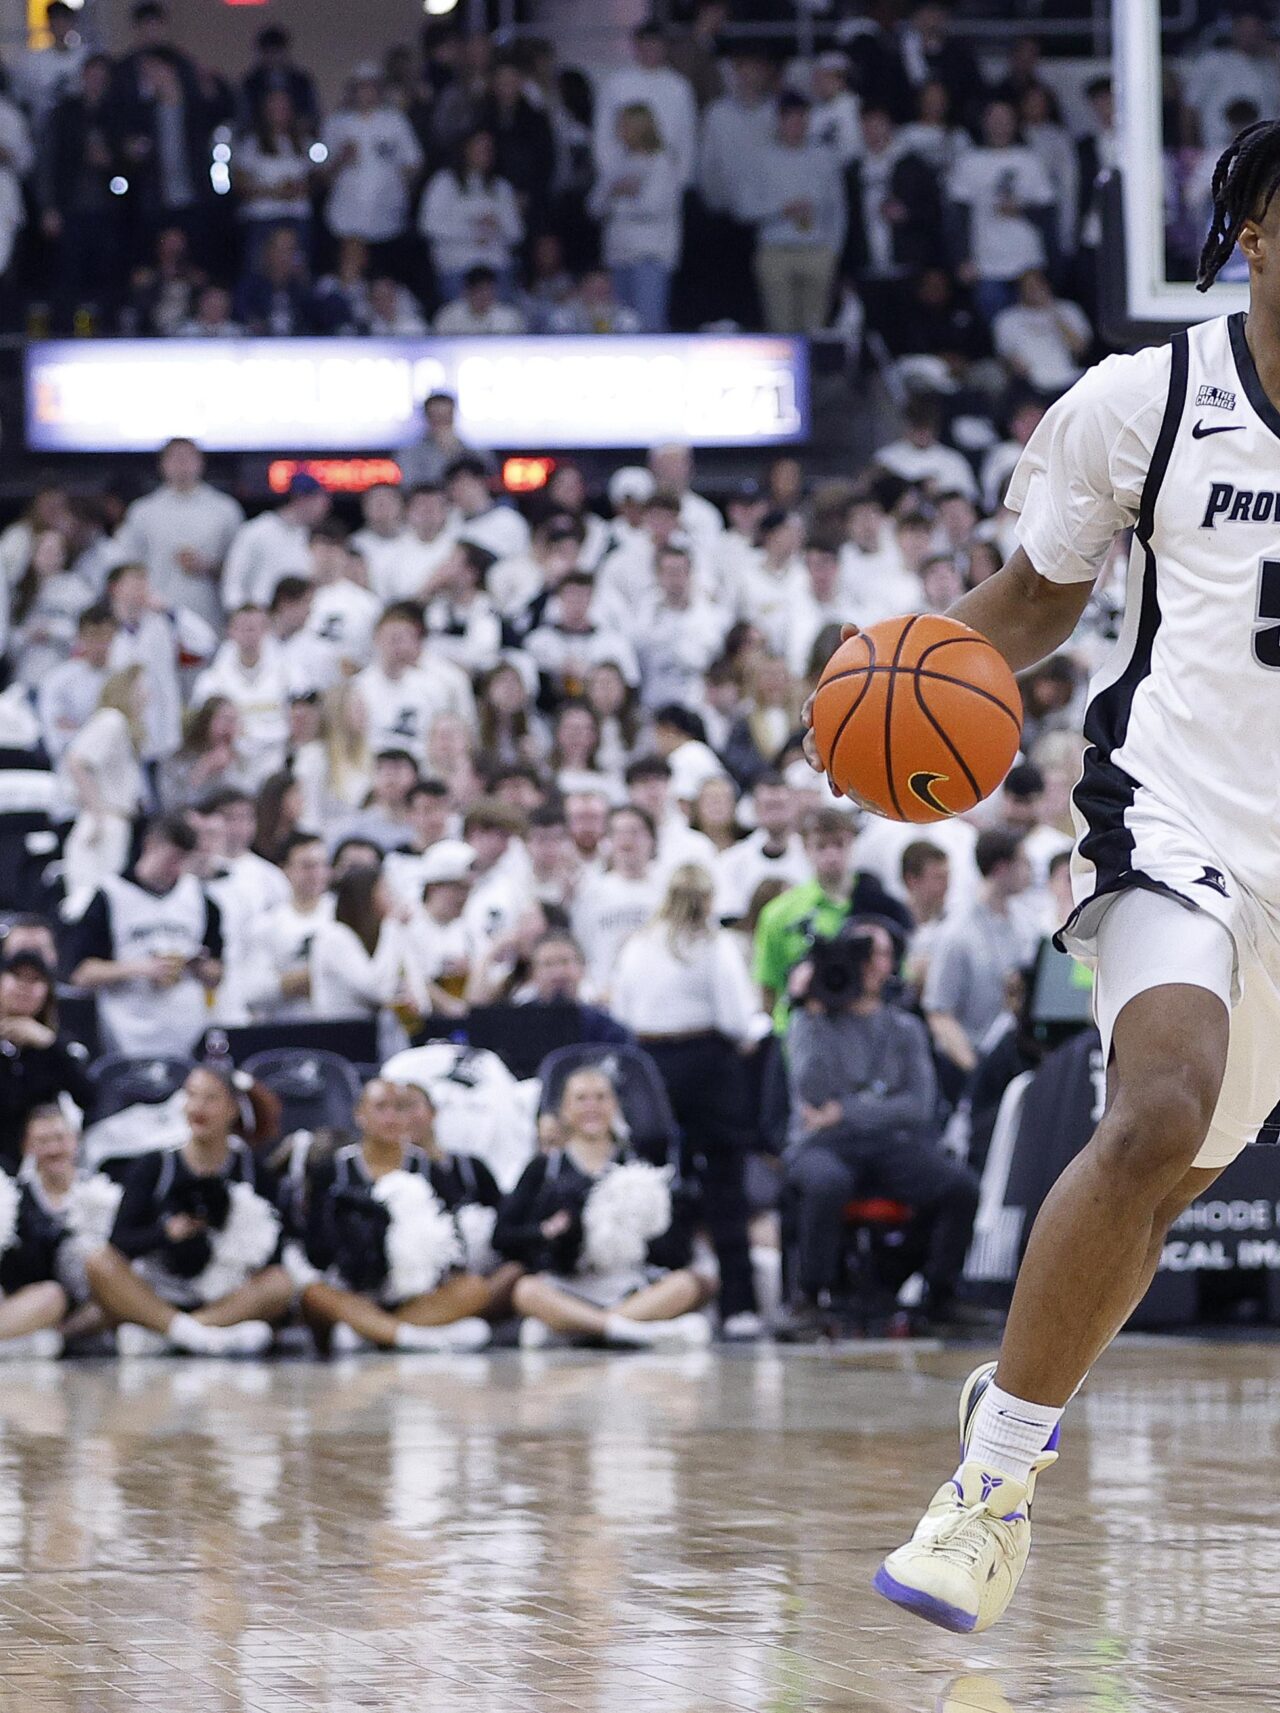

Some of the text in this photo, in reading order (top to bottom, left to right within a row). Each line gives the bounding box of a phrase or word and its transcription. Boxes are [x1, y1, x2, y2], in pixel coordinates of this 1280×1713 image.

[1200, 386, 1236, 401] BE THE
[1196, 396, 1236, 411] CHANGE
